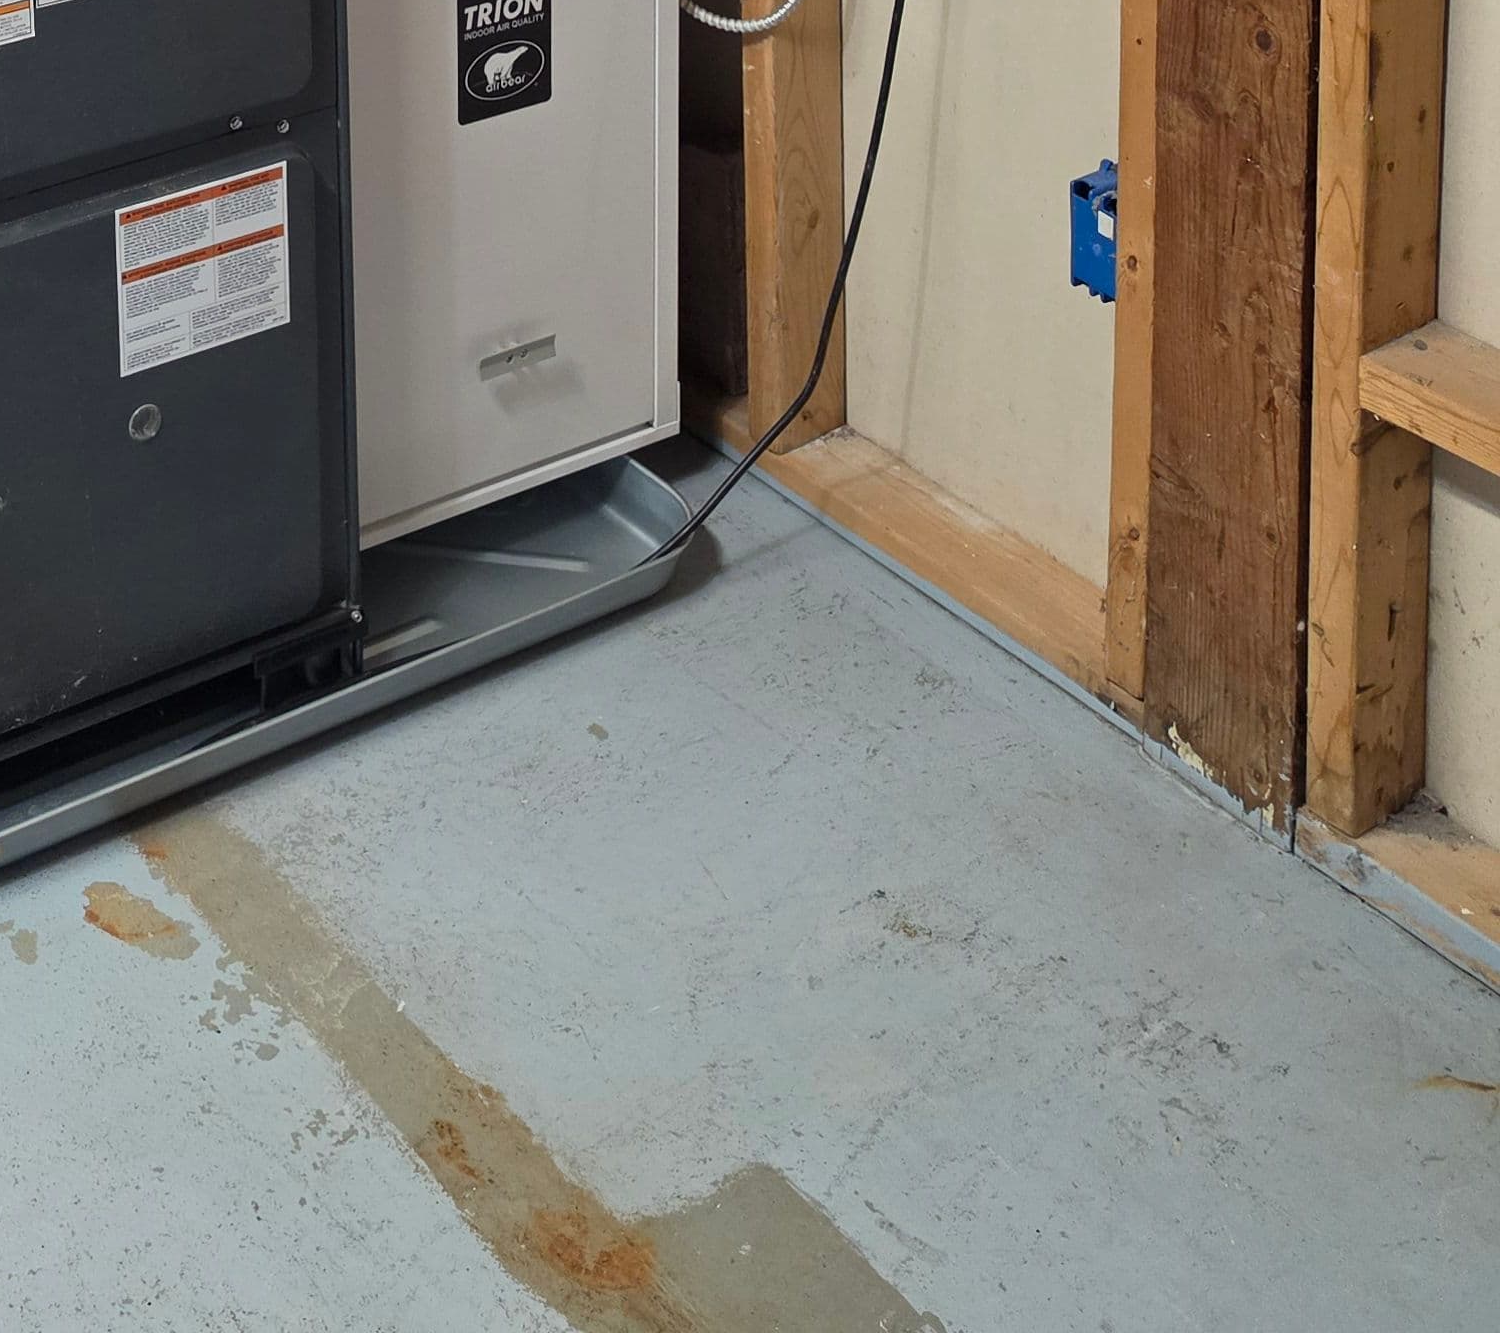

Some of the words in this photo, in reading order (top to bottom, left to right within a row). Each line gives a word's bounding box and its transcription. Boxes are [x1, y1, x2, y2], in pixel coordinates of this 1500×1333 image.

[463, 25, 495, 42] INDOOR
[496, 21, 511, 34] AIR
[511, 12, 545, 30] QUALITY
